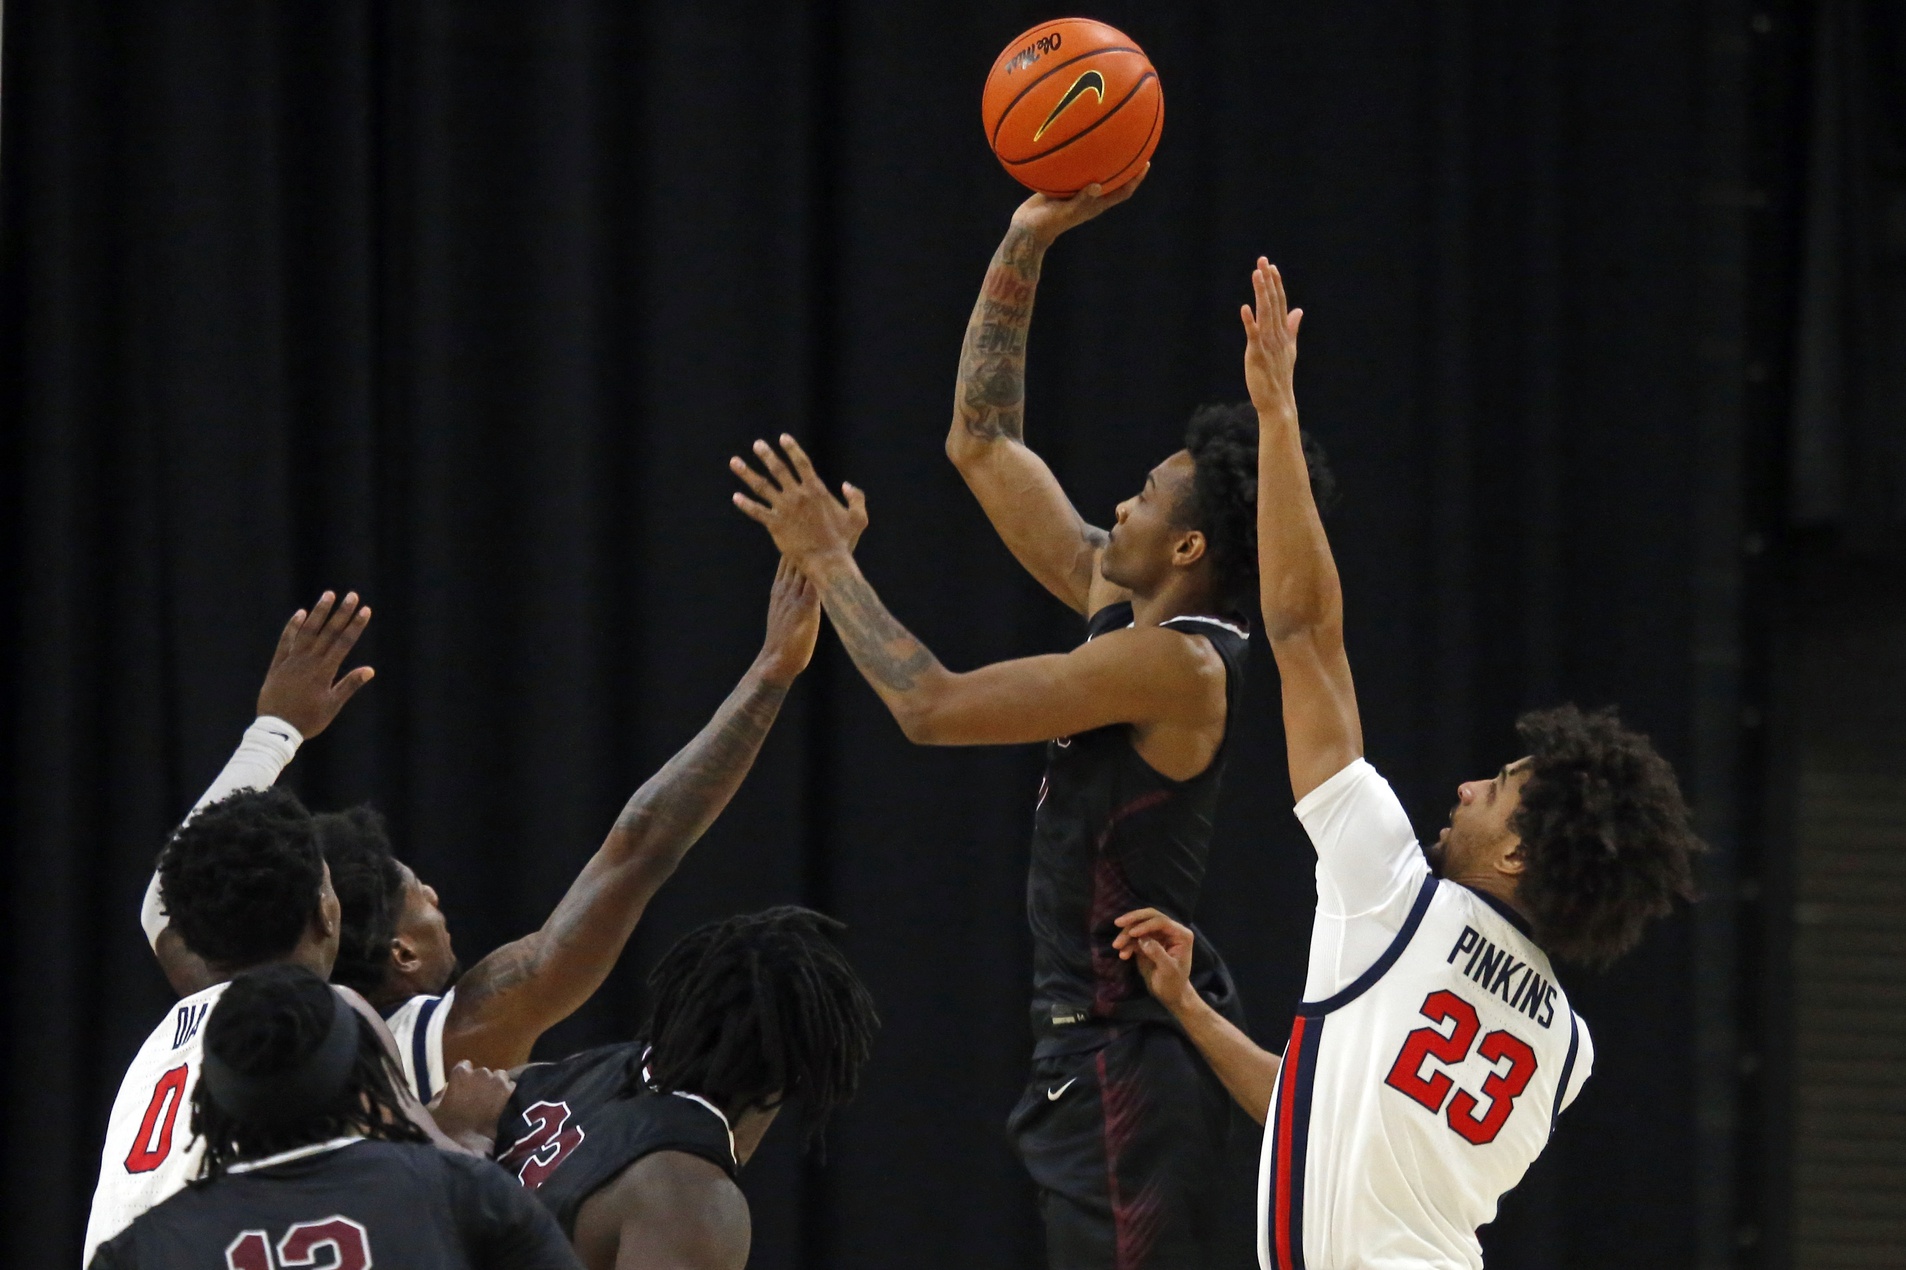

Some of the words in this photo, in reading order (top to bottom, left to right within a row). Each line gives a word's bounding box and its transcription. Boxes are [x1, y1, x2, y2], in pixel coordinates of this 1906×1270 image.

[1447, 925, 1558, 1029] PINKINS
[123, 1061, 189, 1174] 0
[1384, 989, 1539, 1146] 23
